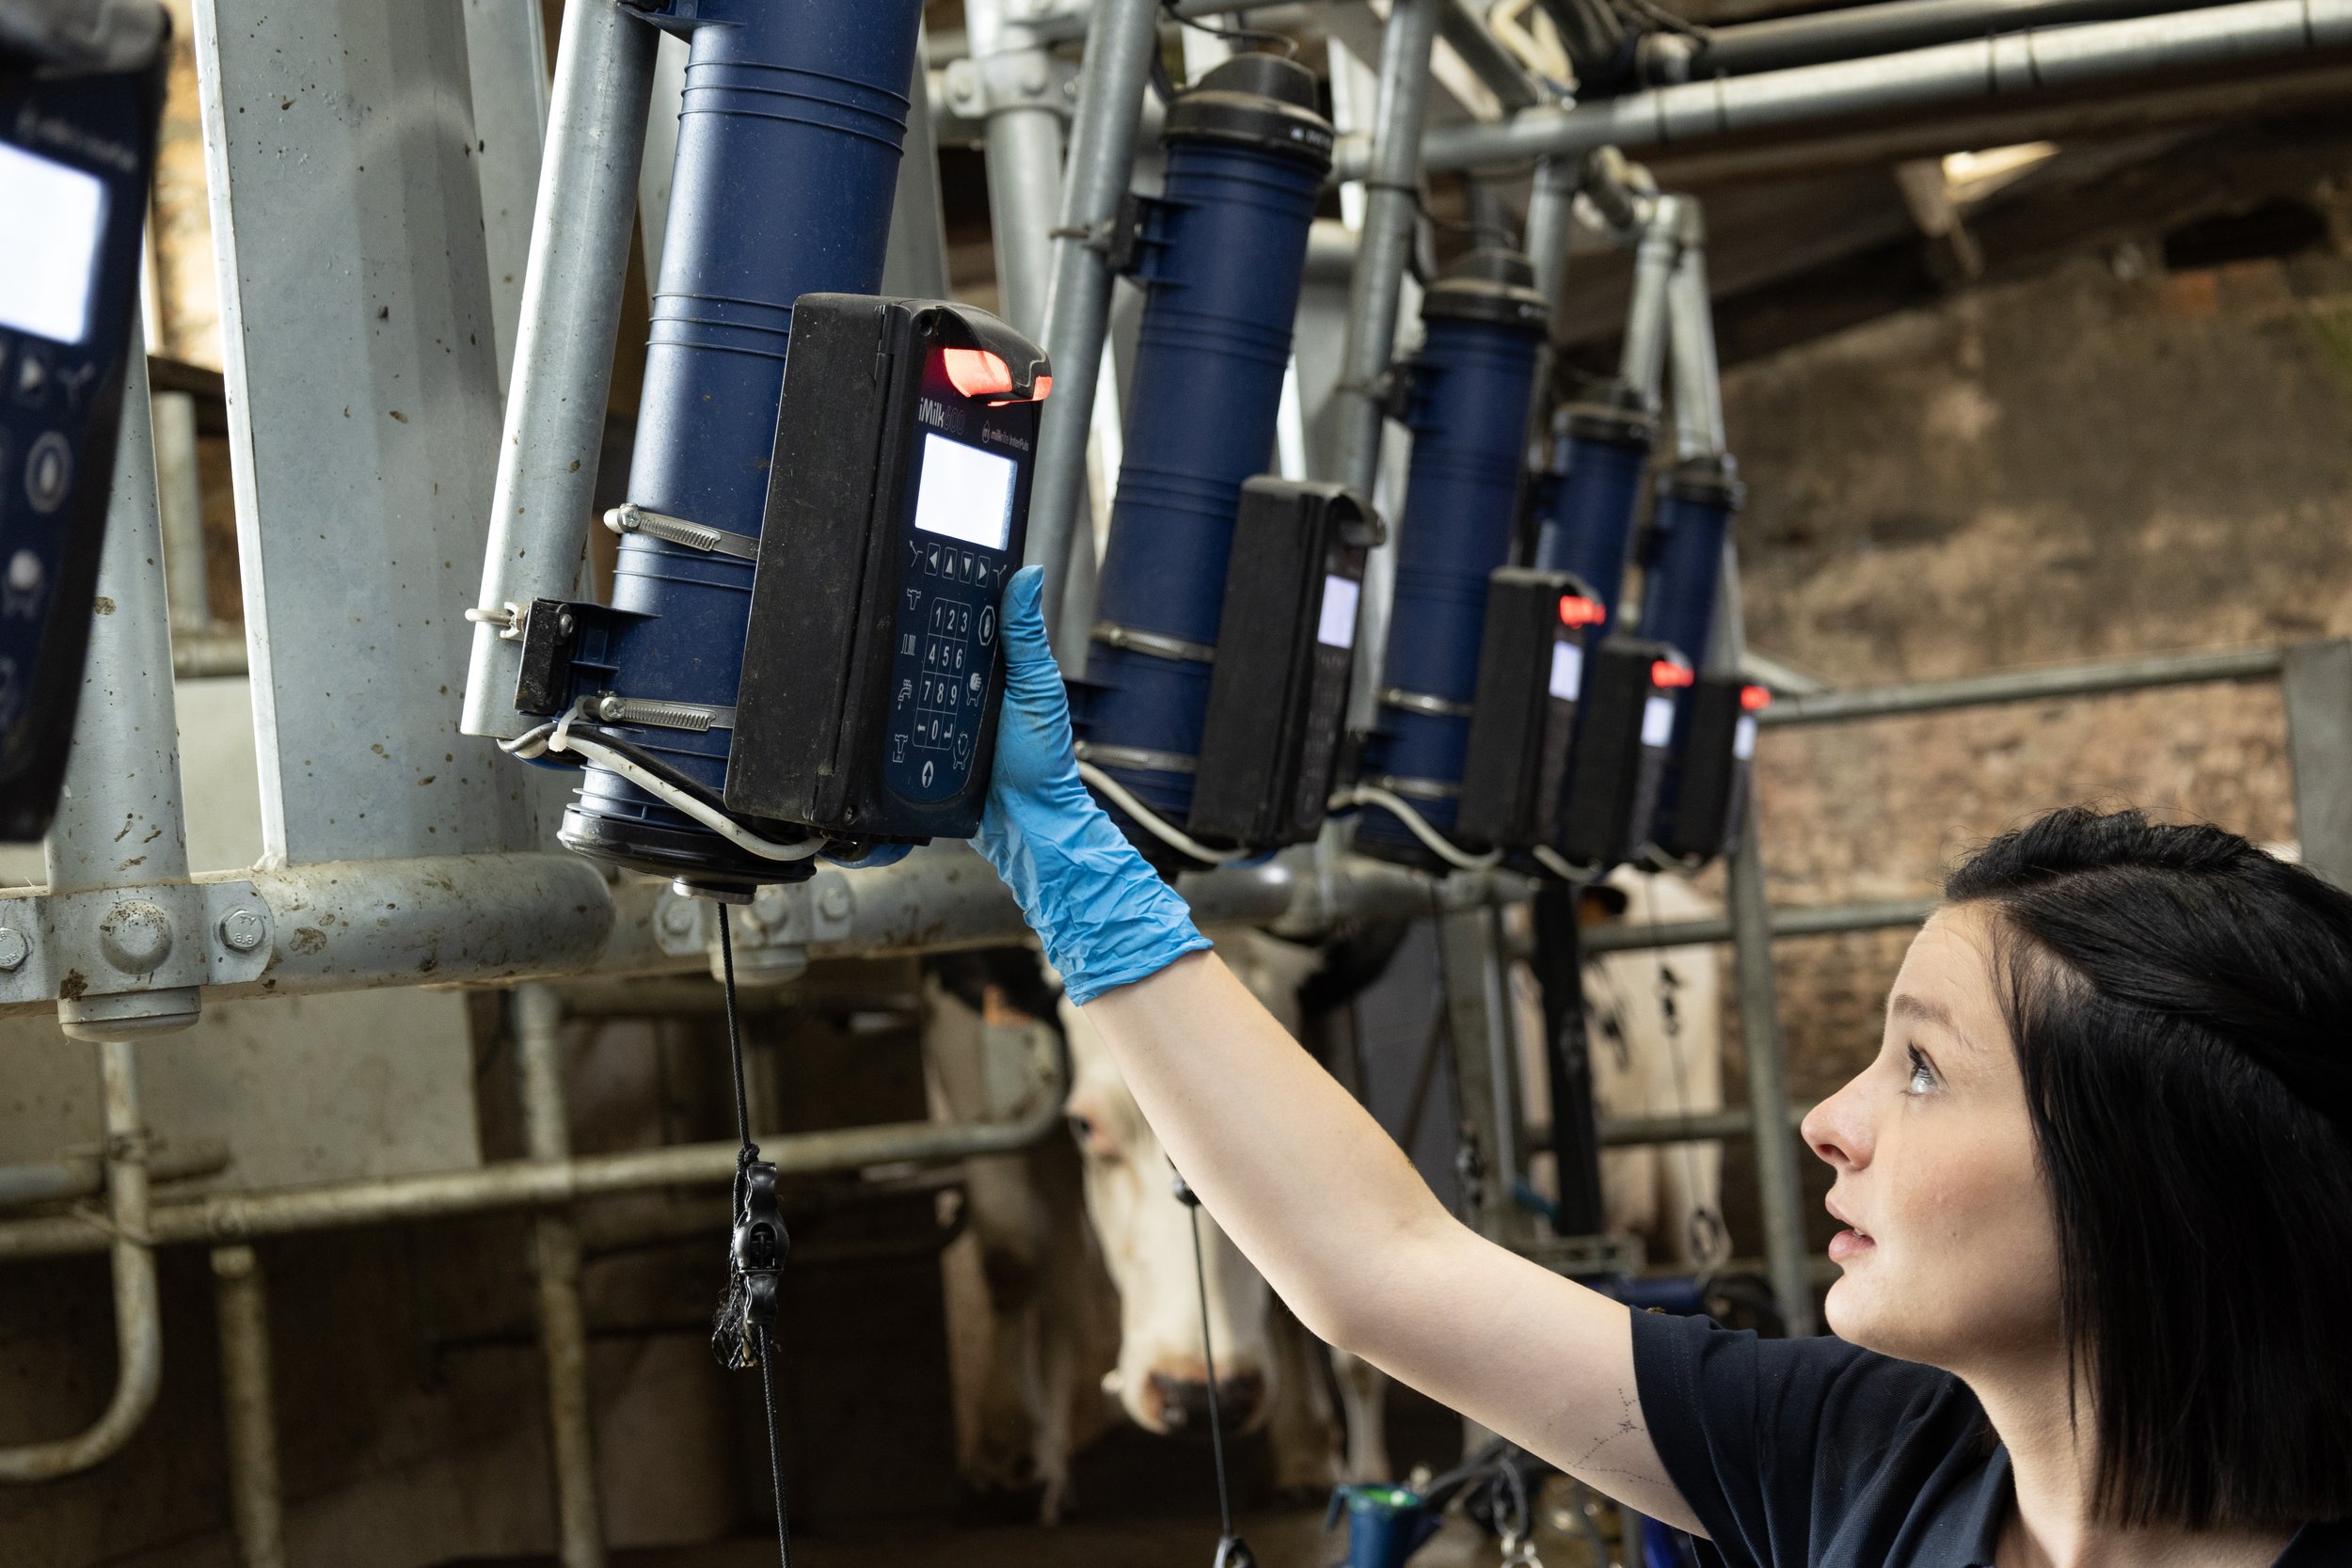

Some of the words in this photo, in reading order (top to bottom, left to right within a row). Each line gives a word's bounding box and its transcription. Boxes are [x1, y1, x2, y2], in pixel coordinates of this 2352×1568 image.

[918, 397, 965, 436] iMilk600
[936, 607, 942, 627] 1
[946, 610, 955, 630] 2
[961, 611, 967, 632] 3
[929, 643, 936, 664] 4
[942, 645, 950, 667] 5
[956, 648, 962, 669] 6
[924, 680, 930, 701] 7
[937, 683, 945, 704] 8
[950, 685, 958, 705] 9
[931, 720, 939, 740] 0
